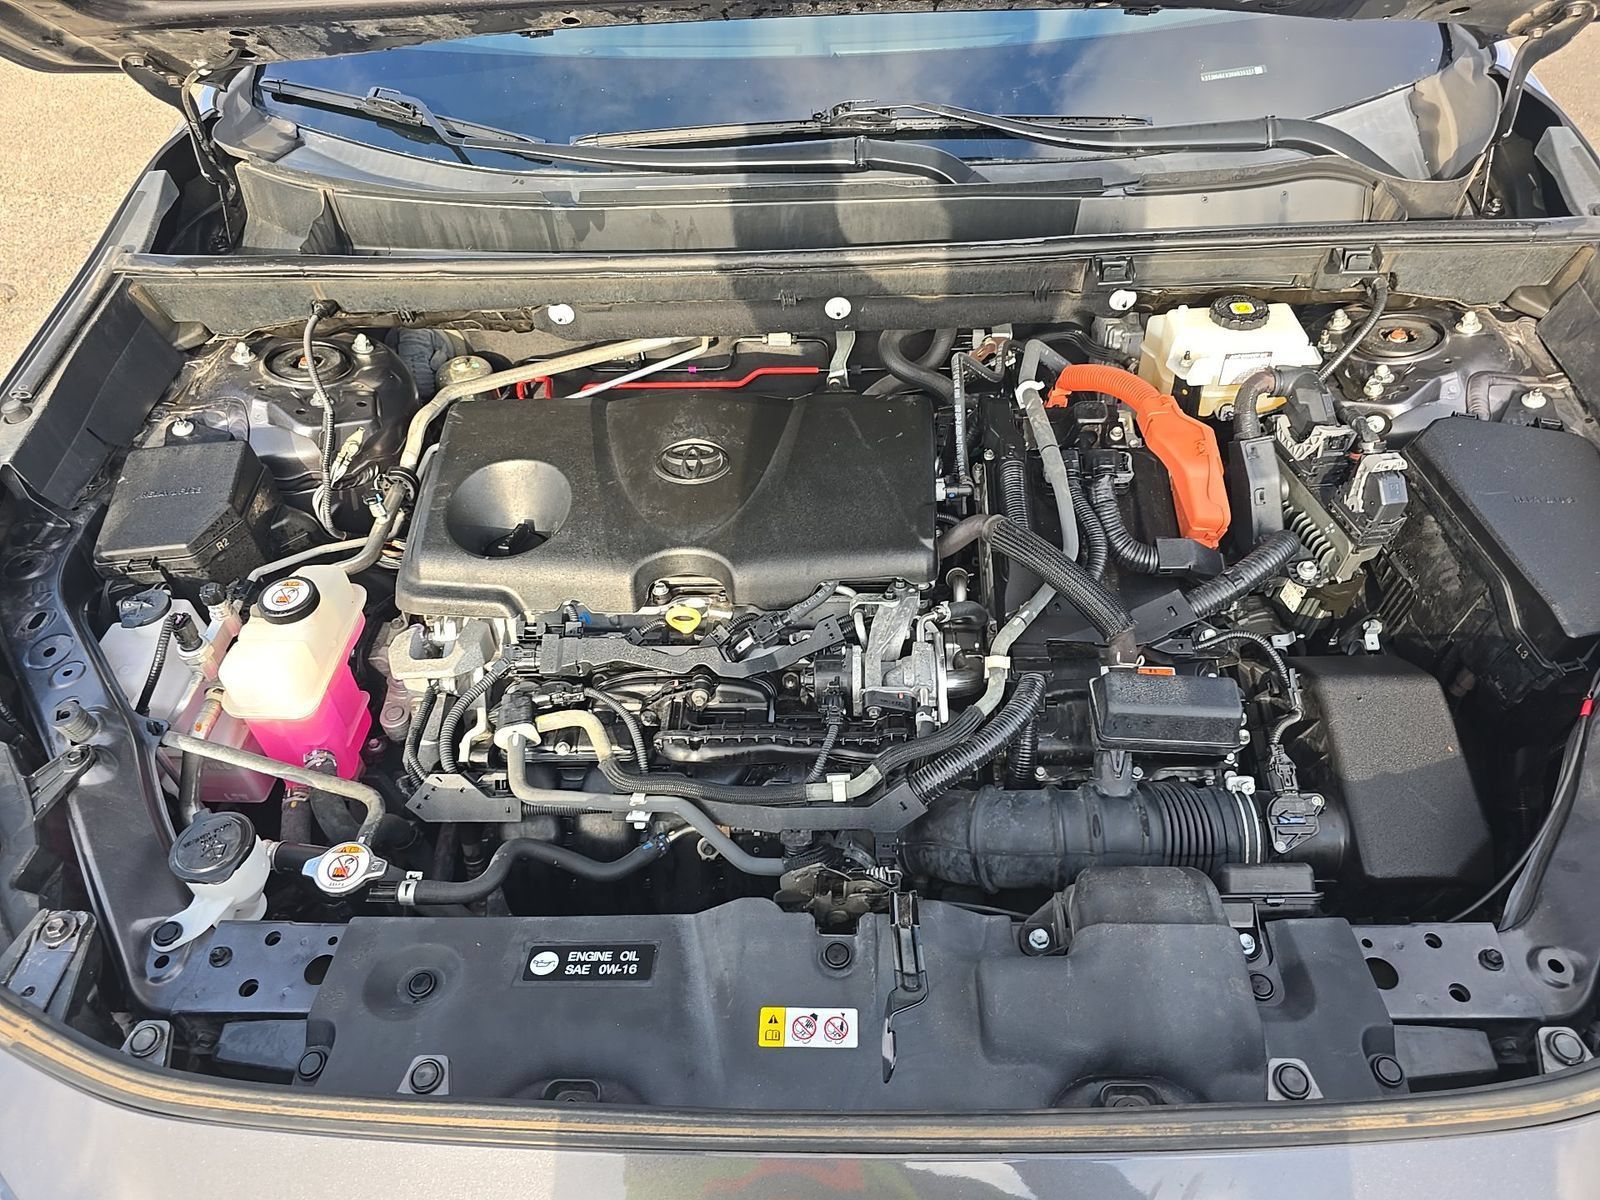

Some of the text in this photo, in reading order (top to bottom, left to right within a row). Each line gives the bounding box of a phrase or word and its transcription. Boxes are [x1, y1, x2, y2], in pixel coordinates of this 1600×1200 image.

[215, 537, 230, 551] R2
[1515, 643, 1528, 659] L3
[567, 951, 640, 962] ENGINE OIL
[564, 964, 638, 975] SAE 0W-16
